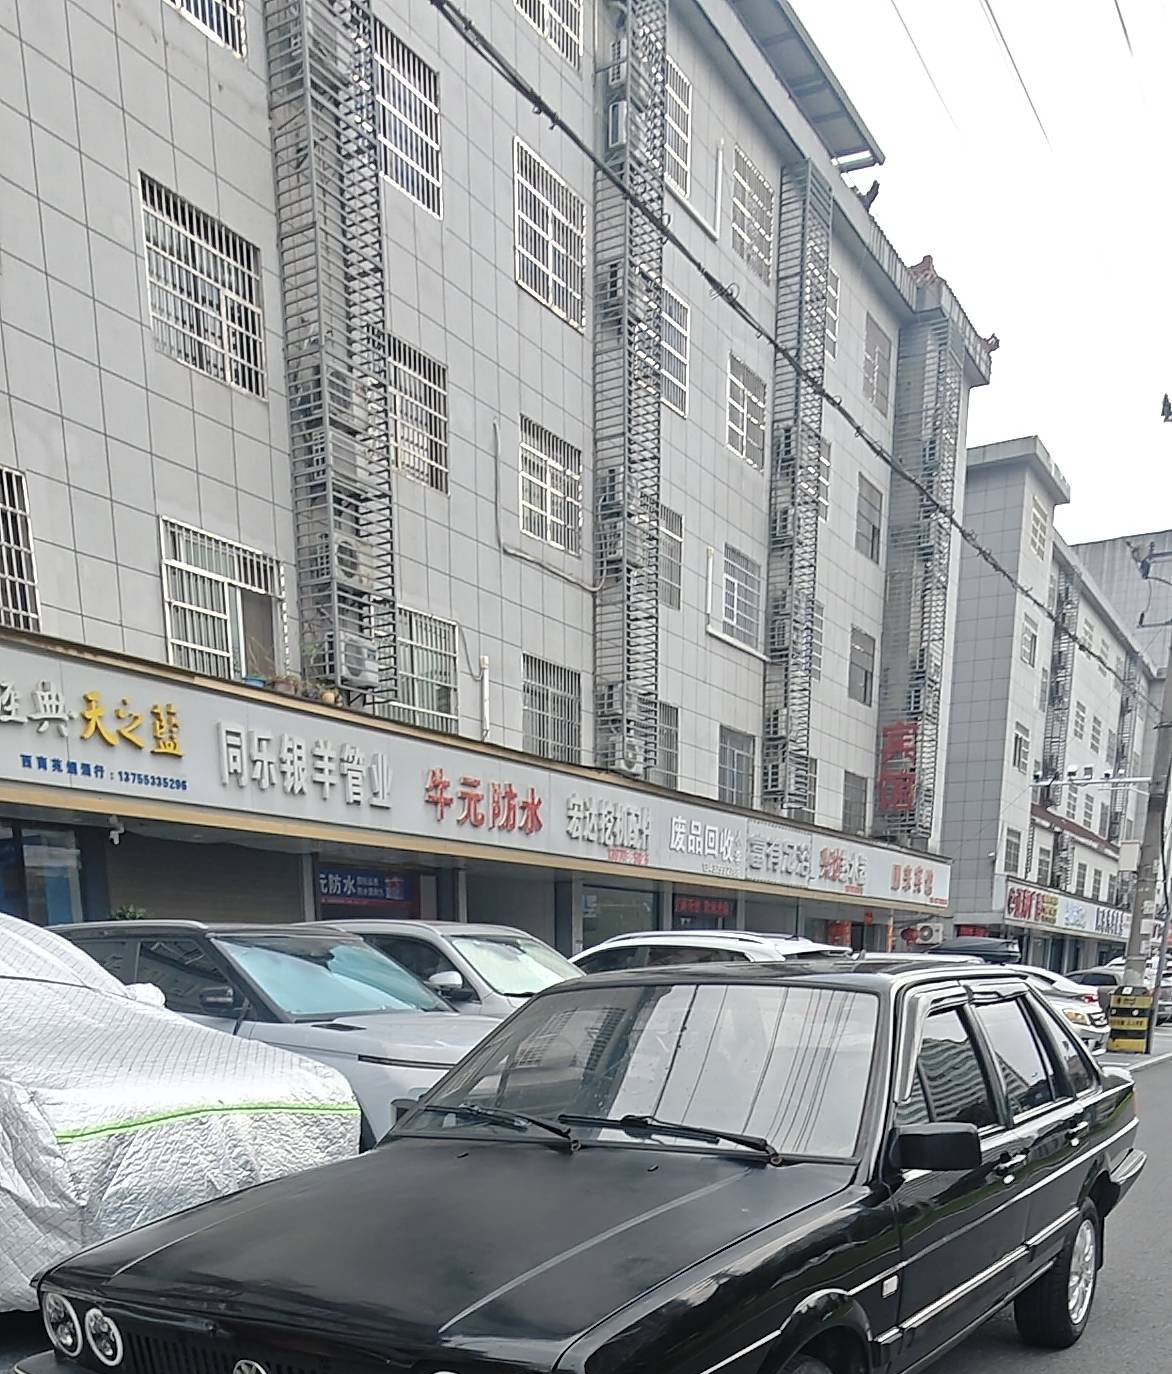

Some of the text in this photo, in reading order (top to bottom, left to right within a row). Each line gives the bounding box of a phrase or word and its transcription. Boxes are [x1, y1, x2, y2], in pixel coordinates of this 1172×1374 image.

[80, 690, 185, 759] 天之蓝
[217, 720, 393, 810] 同乐银羊管业
[424, 768, 544, 835] 牛元防水
[670, 816, 734, 862] 废品回收
